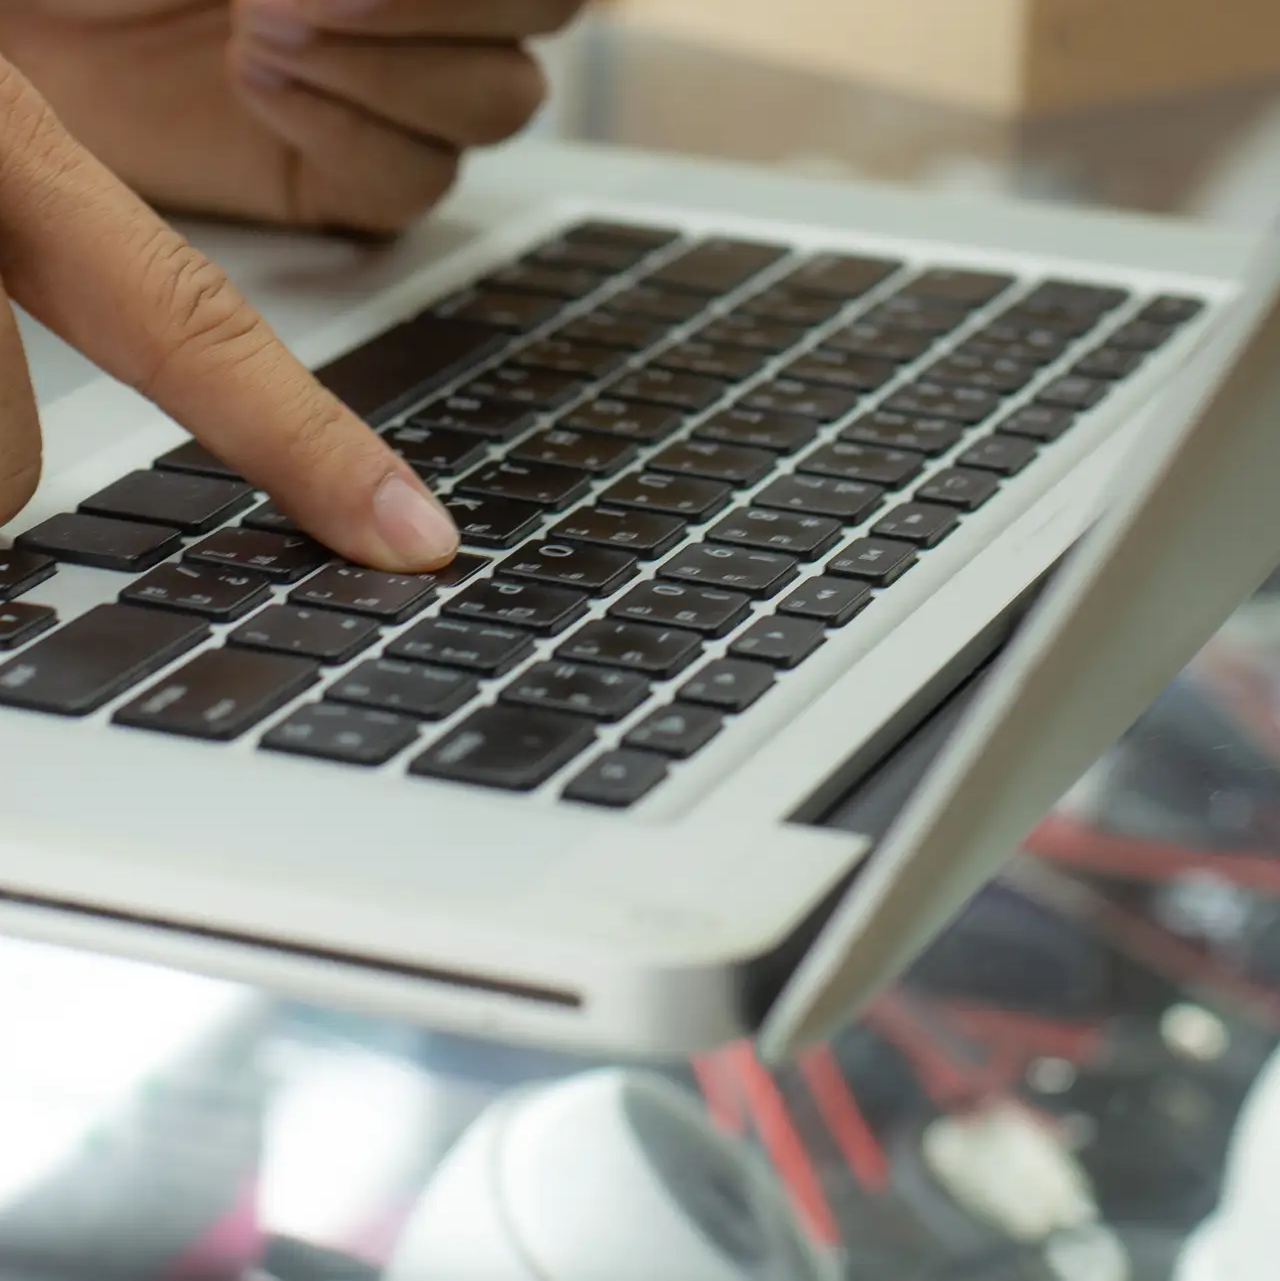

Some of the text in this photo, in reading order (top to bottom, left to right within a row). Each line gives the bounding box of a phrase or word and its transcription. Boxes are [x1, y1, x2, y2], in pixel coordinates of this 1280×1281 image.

[637, 473, 675, 488] U
[445, 496, 484, 511] K
[538, 544, 575, 558] O
[703, 547, 736, 559] 9
[490, 581, 525, 595] P
